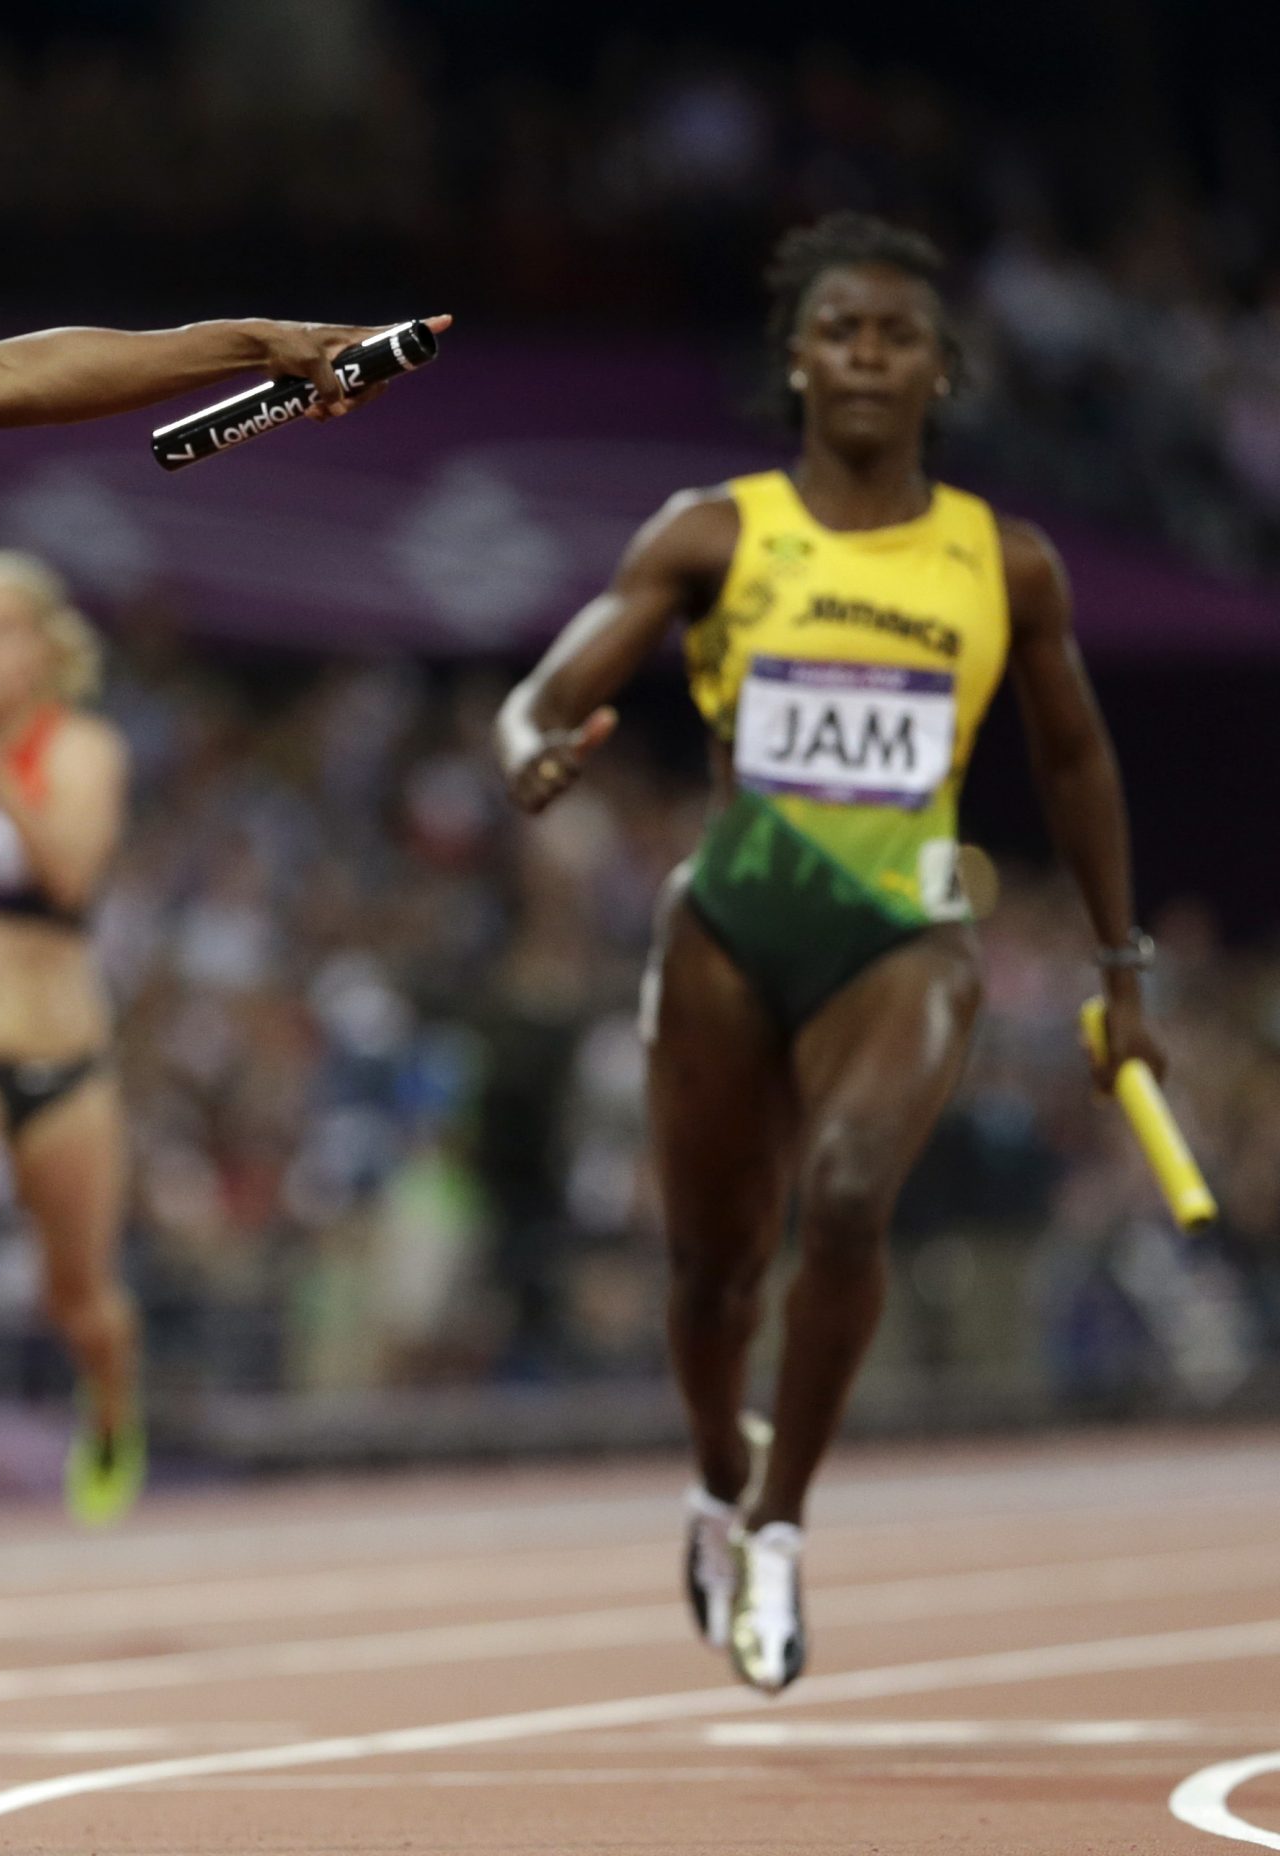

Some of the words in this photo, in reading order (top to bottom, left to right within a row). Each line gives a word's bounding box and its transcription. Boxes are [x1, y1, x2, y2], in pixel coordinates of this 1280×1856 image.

[210, 397, 304, 449] London
[304, 363, 365, 404] 212
[769, 703, 916, 772] JAM
